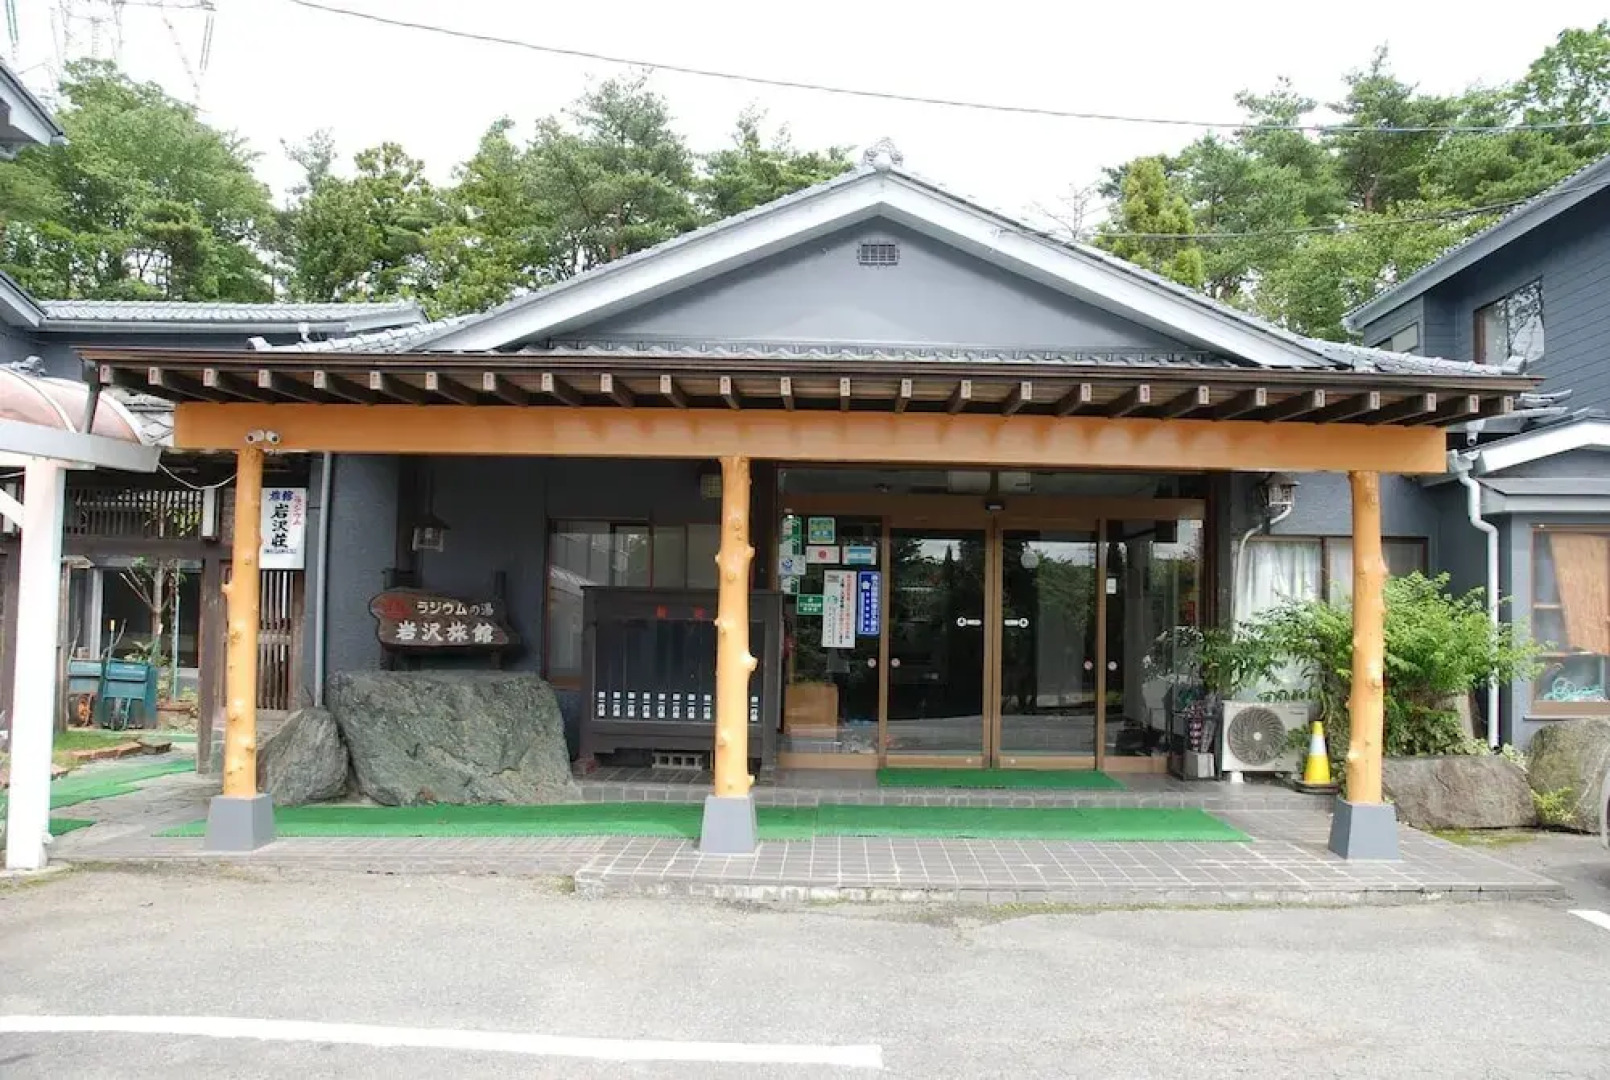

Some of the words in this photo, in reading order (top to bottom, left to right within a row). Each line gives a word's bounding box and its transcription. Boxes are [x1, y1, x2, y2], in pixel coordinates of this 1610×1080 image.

[270, 503, 289, 548] 岩沢荘
[416, 601, 494, 616] ラジウムの湯
[396, 620, 494, 643] 岩沢旅館
